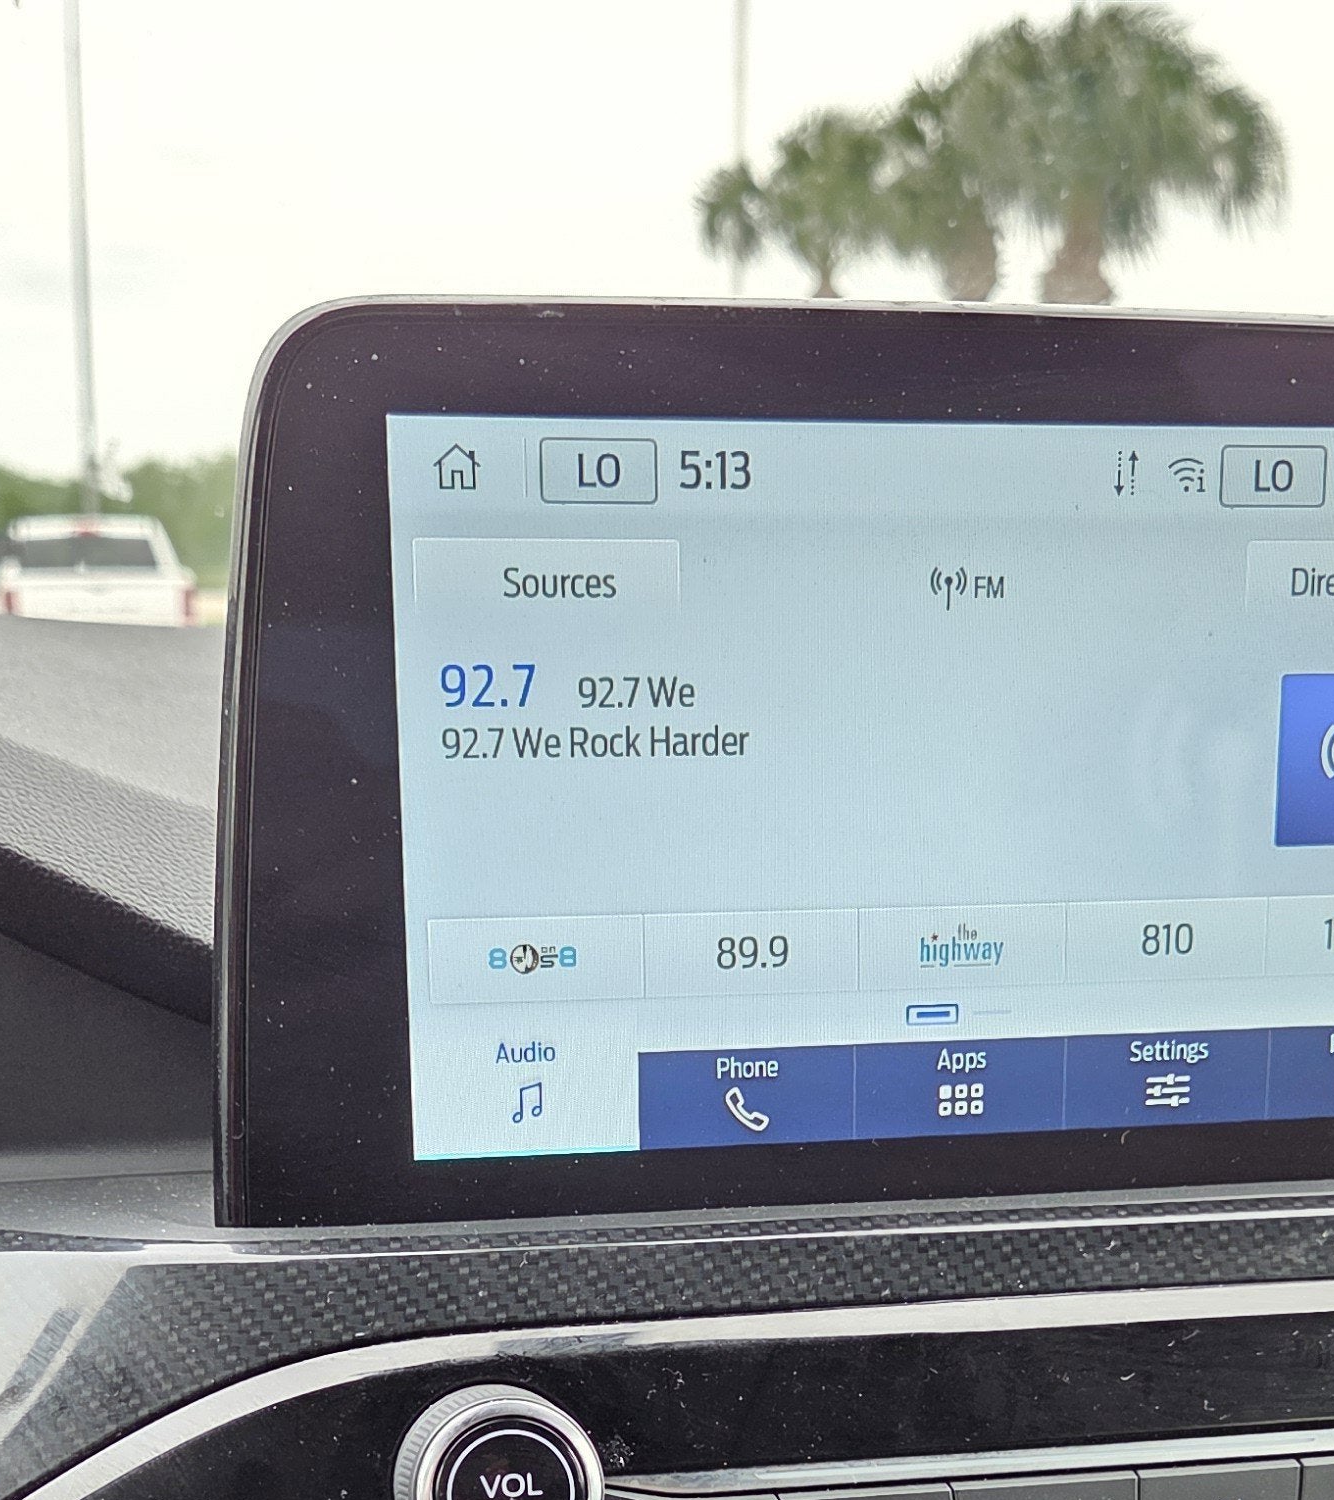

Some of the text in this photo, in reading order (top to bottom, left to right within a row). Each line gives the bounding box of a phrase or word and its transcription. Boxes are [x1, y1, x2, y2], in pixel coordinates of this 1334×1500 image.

[578, 452, 621, 488] LO
[679, 450, 752, 490] 5:13
[1254, 460, 1294, 492] LO
[503, 567, 617, 599] Sources
[973, 576, 1005, 600] FM
[440, 664, 695, 709] 92.7 92.7 We
[442, 724, 749, 760] 92.7 We Rock Harder
[717, 935, 789, 971] 89.9
[920, 932, 1004, 968] highway
[1141, 922, 1193, 956] 810
[495, 1042, 556, 1065] Audio
[716, 1057, 779, 1080] Phone
[937, 1048, 987, 1074] Apps
[1129, 1039, 1209, 1066] Settings
[478, 1472, 544, 1499] VOL
